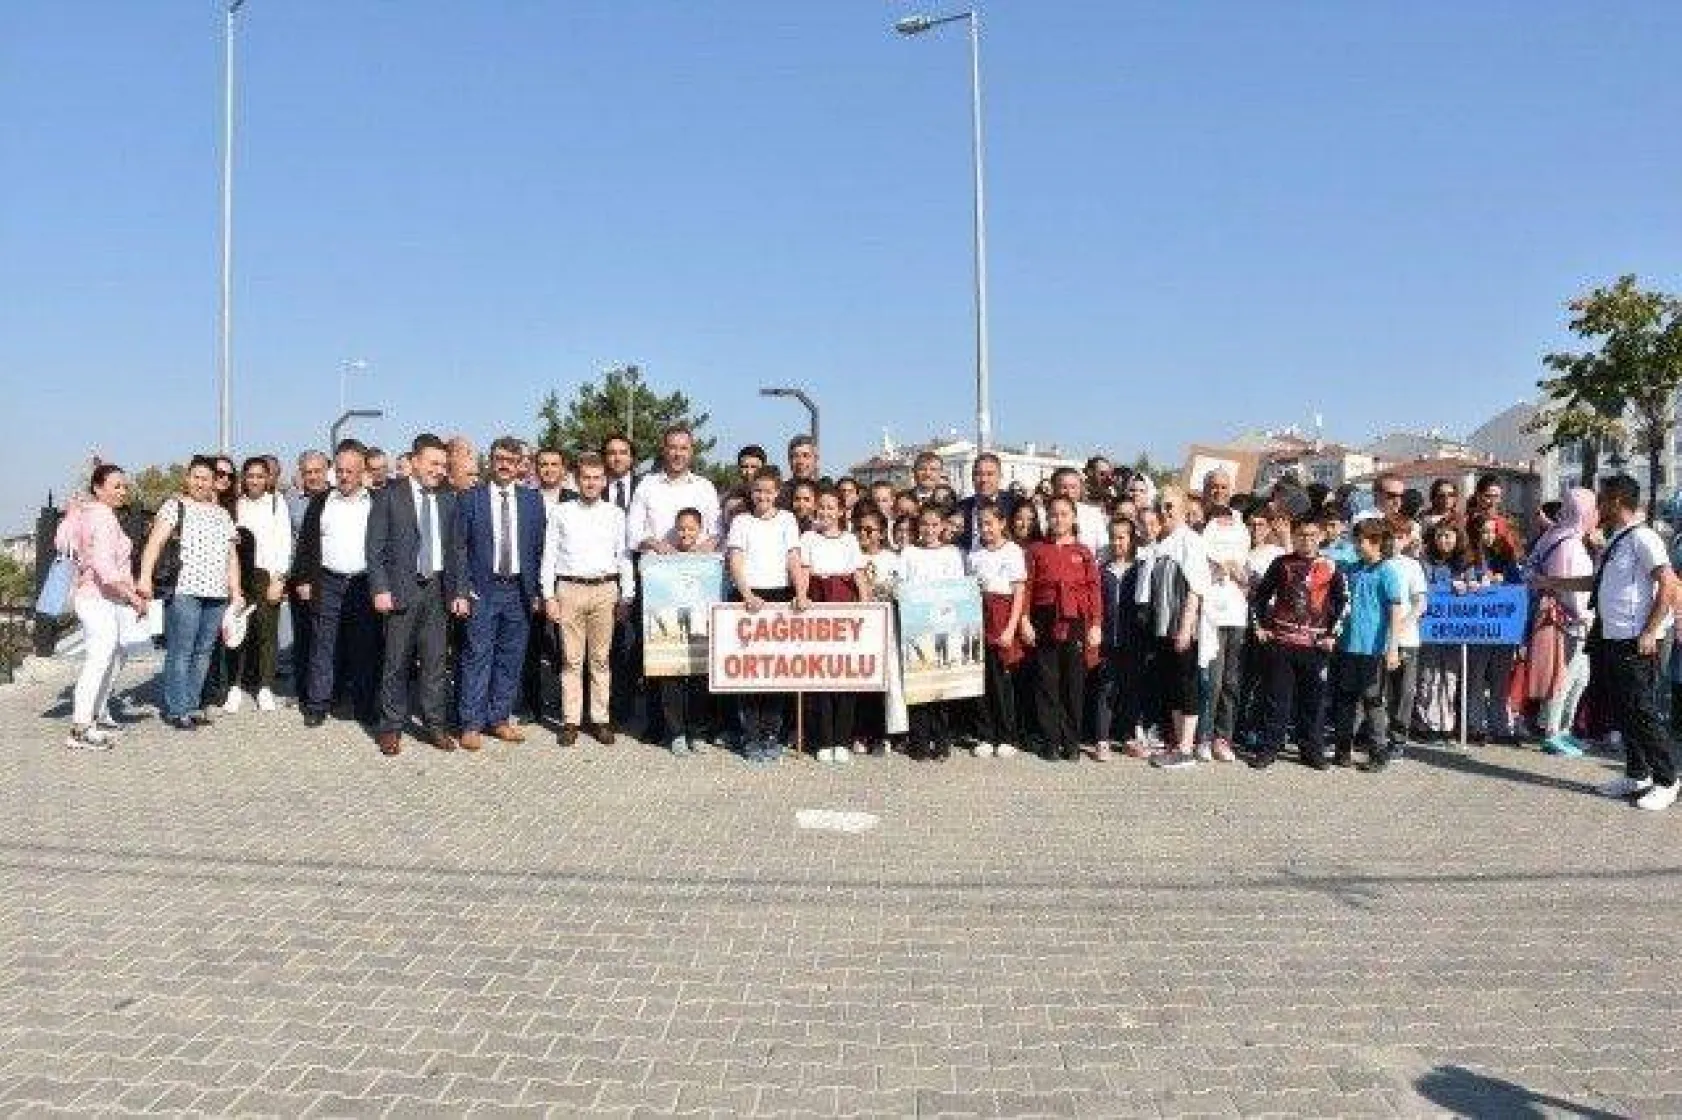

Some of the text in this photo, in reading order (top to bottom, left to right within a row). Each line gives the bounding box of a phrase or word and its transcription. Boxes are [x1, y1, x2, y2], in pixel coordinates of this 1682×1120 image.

[737, 613, 865, 647] ÇAĞRIBEY
[1431, 622, 1502, 638] ORTAOKULU
[724, 654, 876, 679] ORTAOKULU
